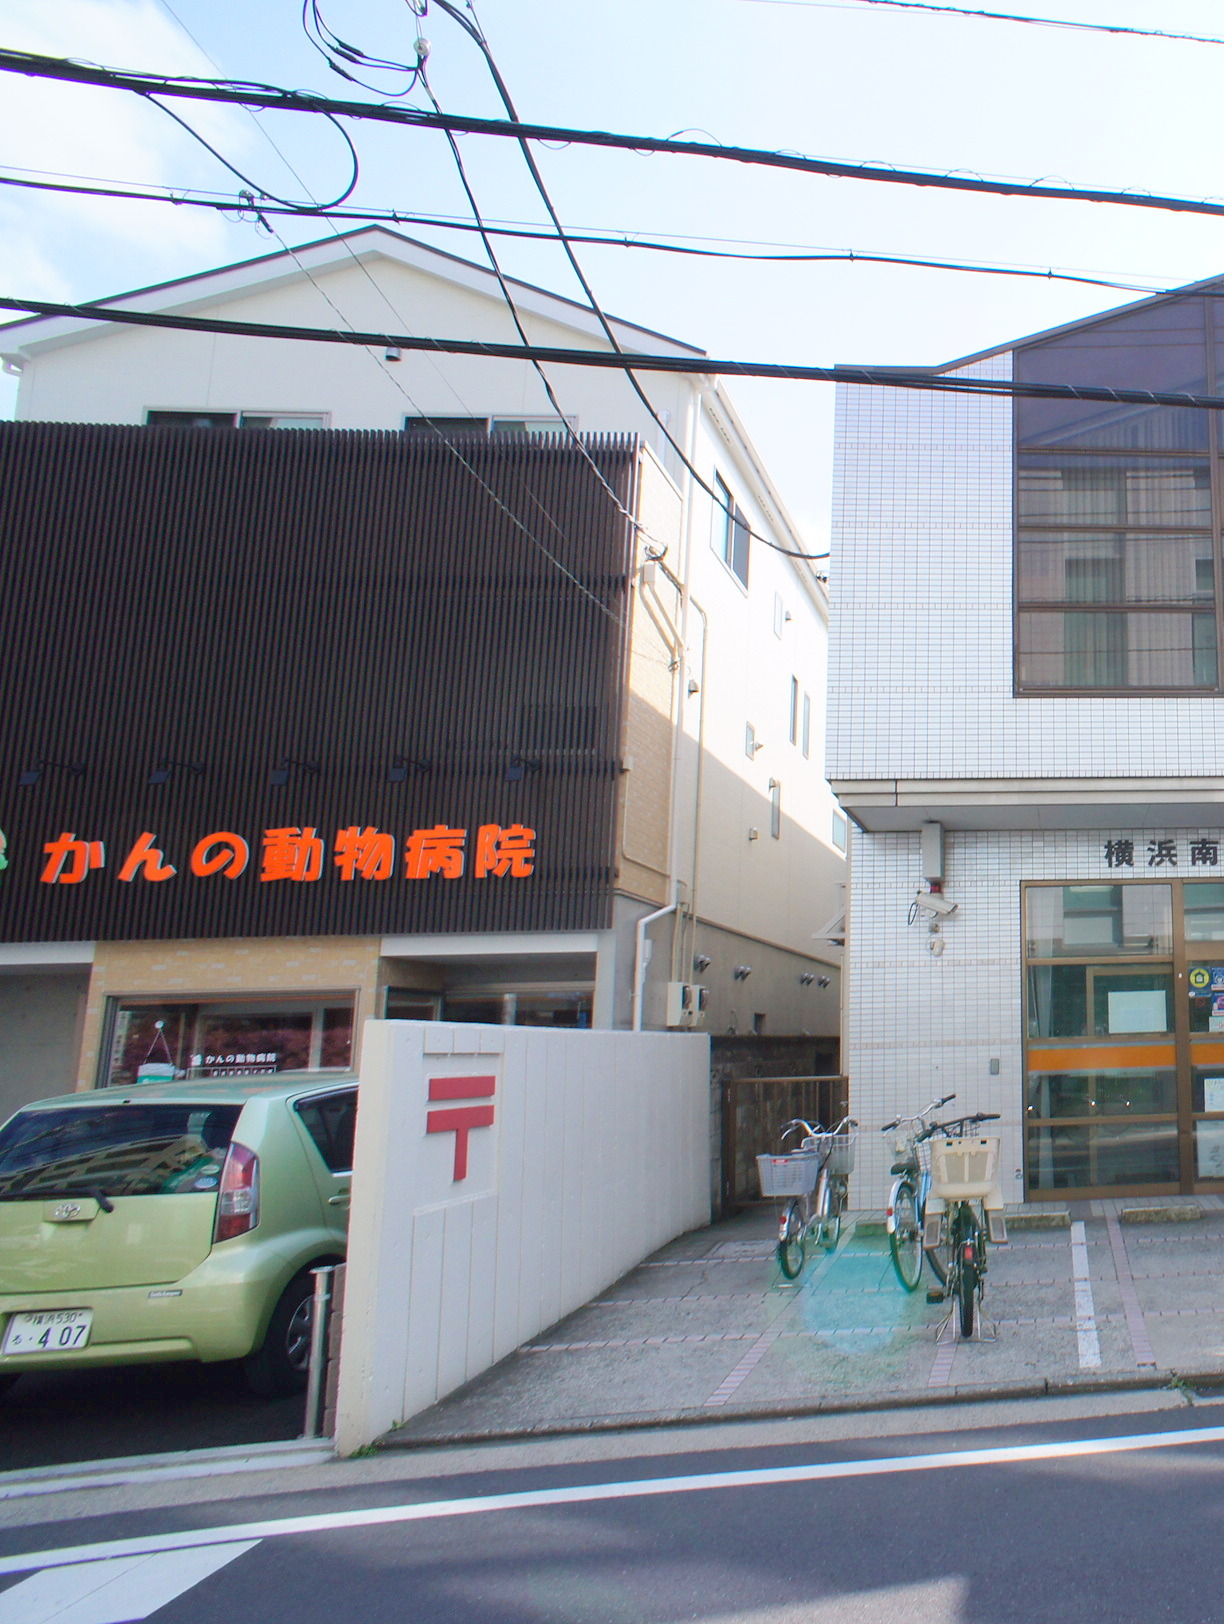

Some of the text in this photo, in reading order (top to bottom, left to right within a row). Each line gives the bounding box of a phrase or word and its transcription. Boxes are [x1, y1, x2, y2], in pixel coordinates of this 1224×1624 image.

[40, 823, 537, 885] かんの動物病院
[205, 1052, 277, 1064] かんの動物病院
